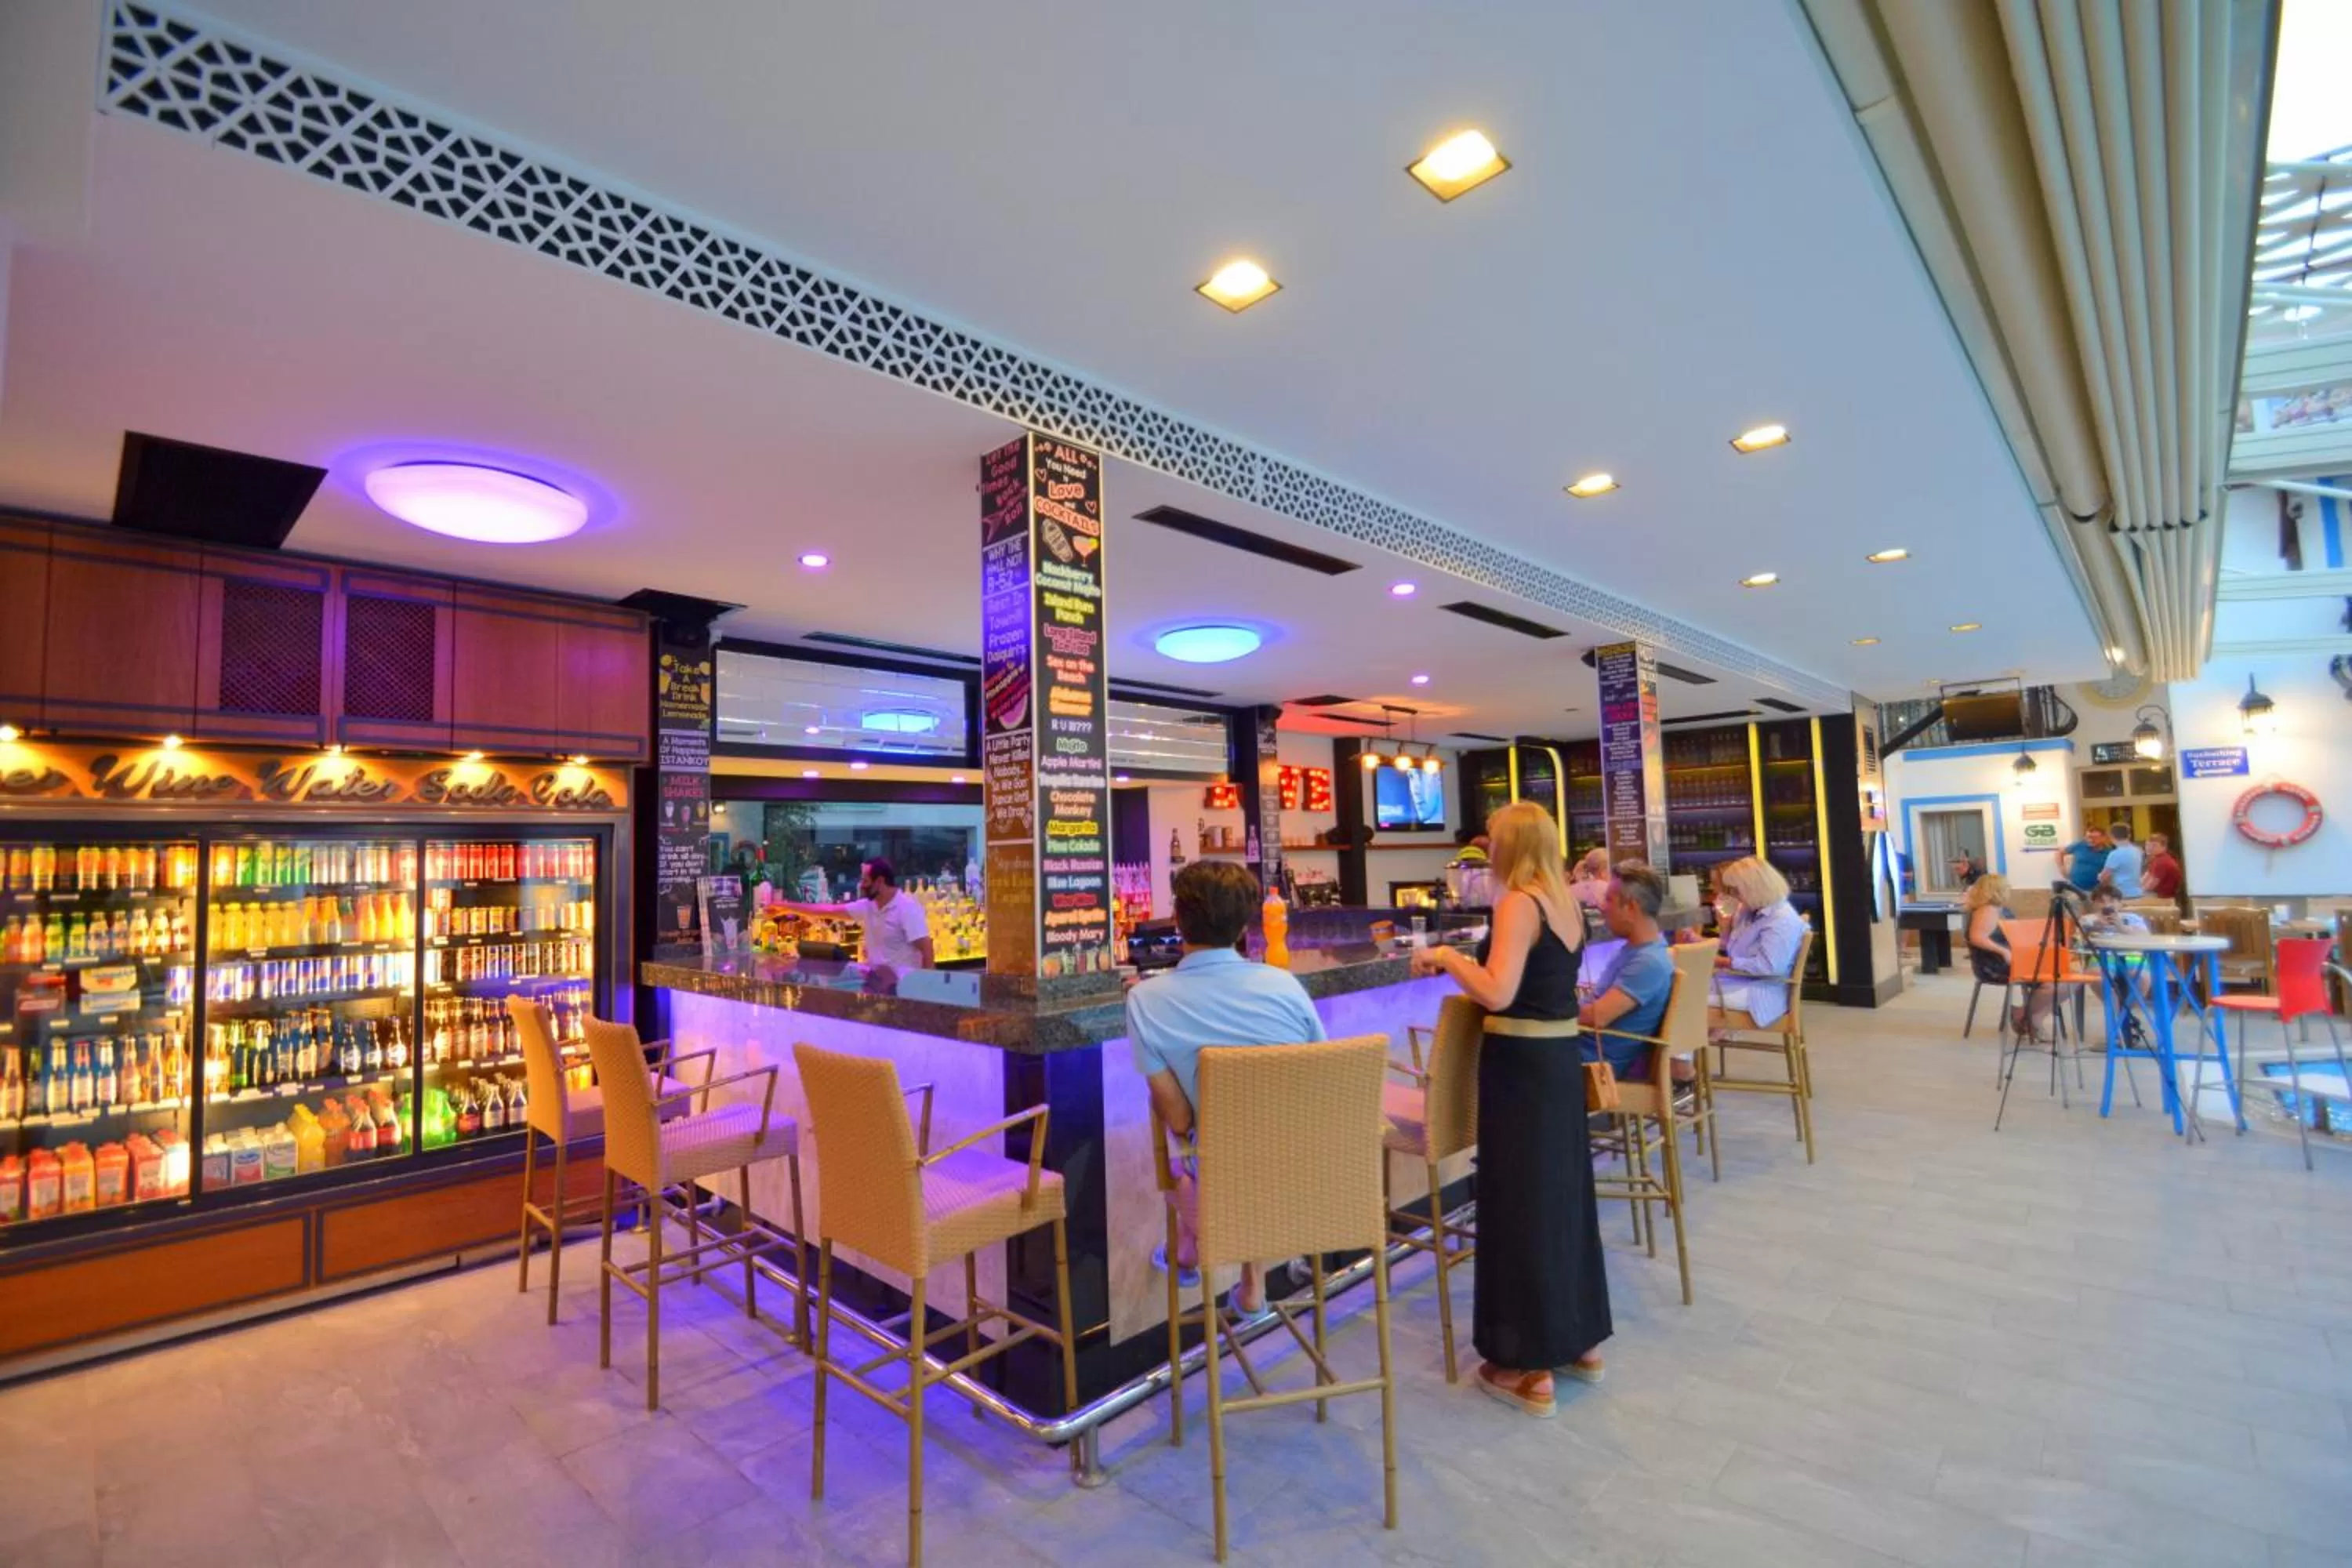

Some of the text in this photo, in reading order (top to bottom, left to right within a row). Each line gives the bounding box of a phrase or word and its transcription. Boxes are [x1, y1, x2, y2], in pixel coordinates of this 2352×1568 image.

[1054, 445, 1078, 464] ALL
[1034, 495, 1099, 536] COCKTAILS
[257, 759, 401, 798] Water
[422, 766, 517, 802] Soda
[531, 770, 614, 806] Cola
